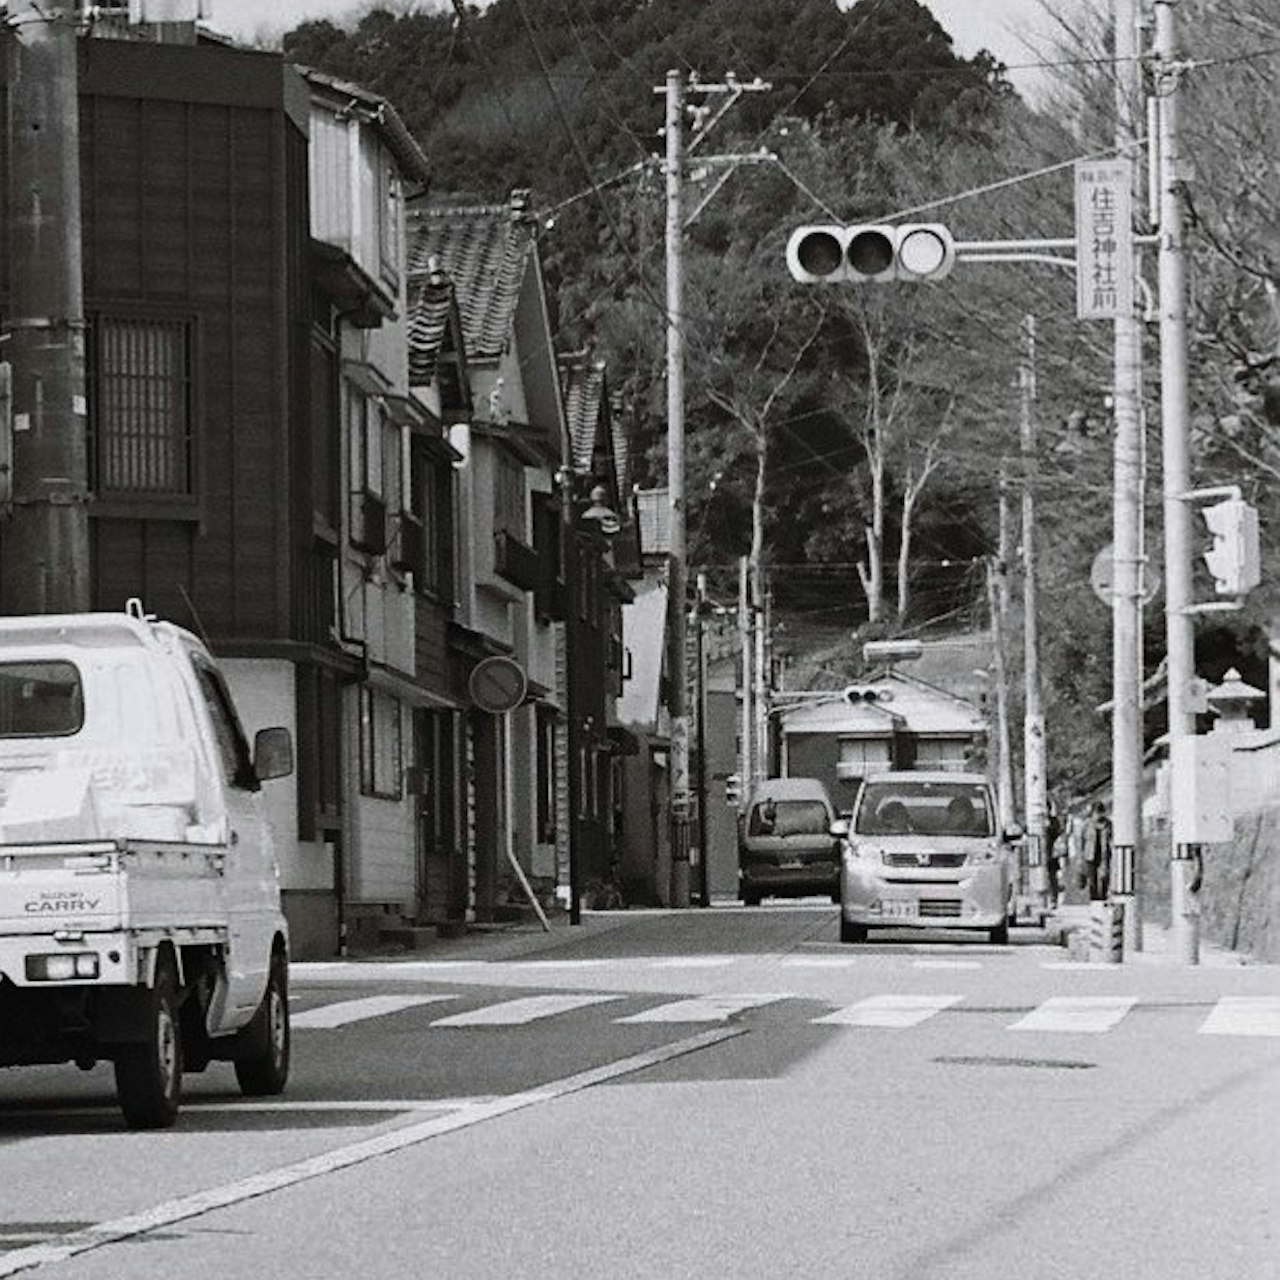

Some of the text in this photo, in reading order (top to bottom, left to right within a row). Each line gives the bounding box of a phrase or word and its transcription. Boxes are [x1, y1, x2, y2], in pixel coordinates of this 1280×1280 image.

[1092, 186, 1118, 310] 住吉神社前
[24, 898, 101, 912] CARRY
